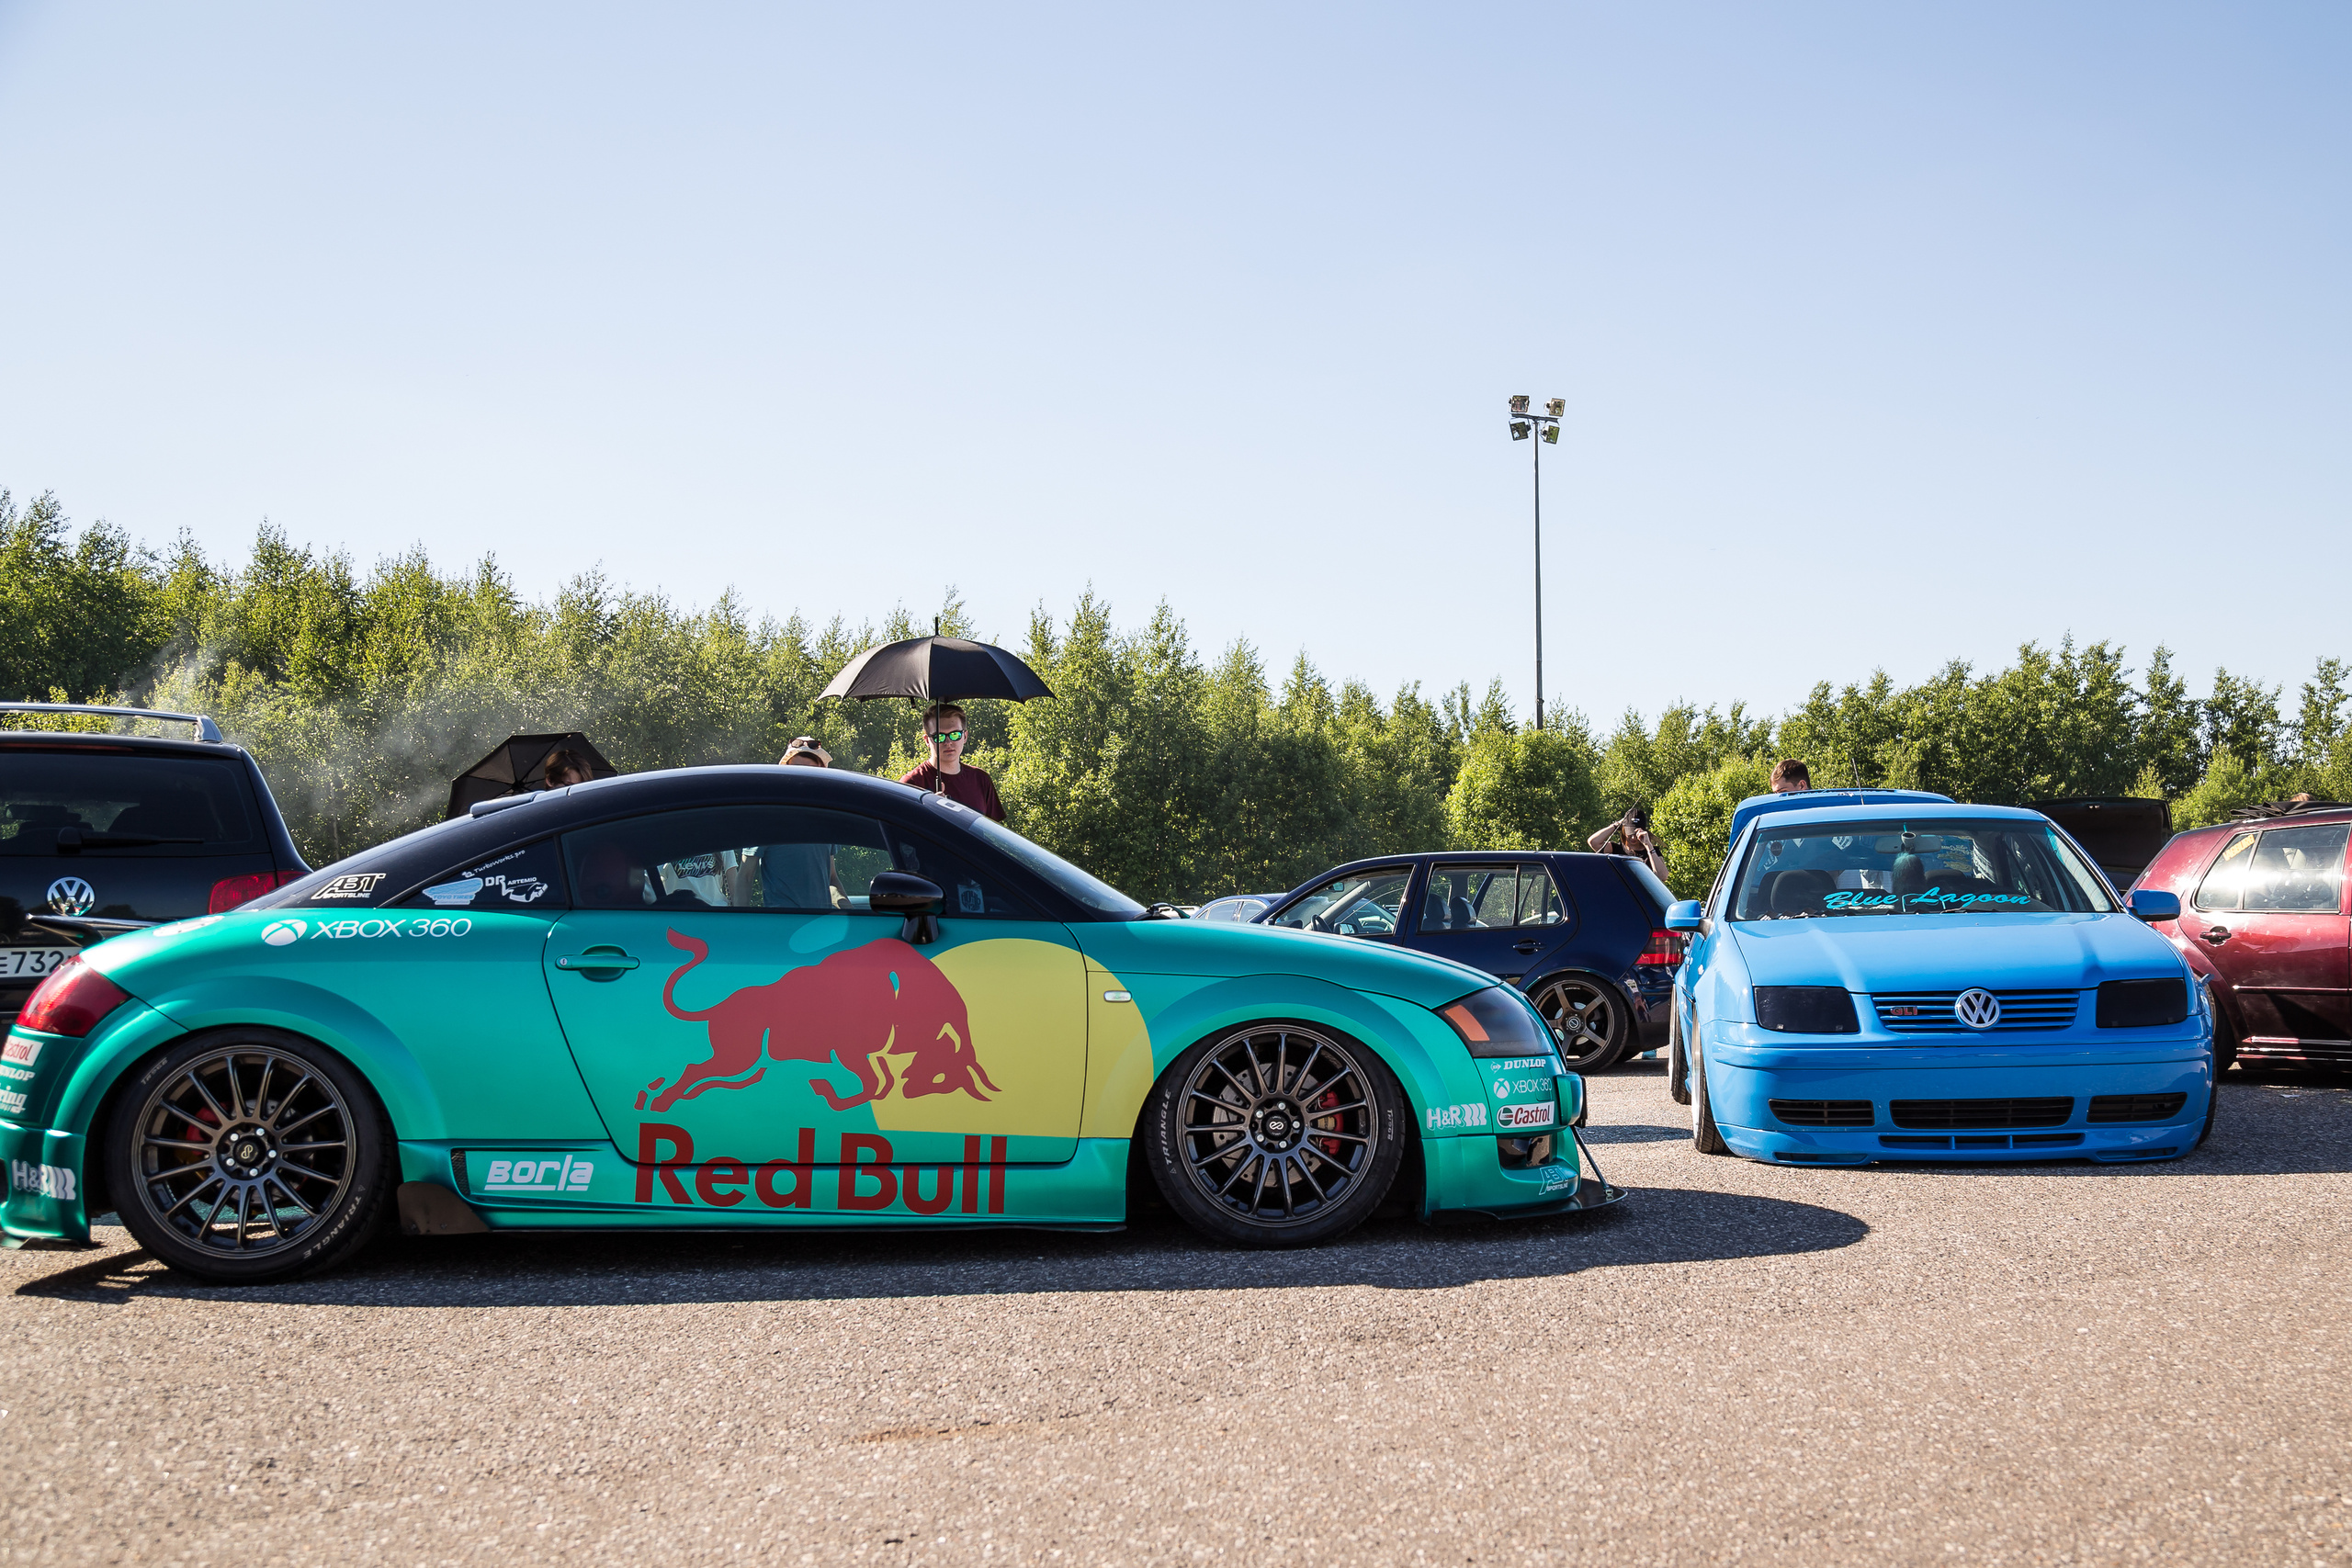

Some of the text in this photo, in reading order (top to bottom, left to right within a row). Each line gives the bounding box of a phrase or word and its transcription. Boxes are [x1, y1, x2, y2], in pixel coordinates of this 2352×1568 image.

[474, 850, 526, 873] TurboWorks.pro
[311, 873, 386, 899] ABT
[485, 874, 537, 893] DR ARTEMIO
[1823, 886, 2031, 909] Blue Lagoon
[310, 919, 472, 940] XBOX 360
[1891, 1006, 1918, 1016] GLI
[1503, 1058, 1546, 1070] DUNLOP
[1512, 1077, 1553, 1094] XBOX 360
[1427, 1104, 1473, 1131] H&R
[1514, 1104, 1551, 1125] Castrol
[1160, 1089, 1172, 1166] TRIANGLE
[635, 1122, 1008, 1215] Red Bull
[303, 1196, 362, 1259] TRIANGLE
